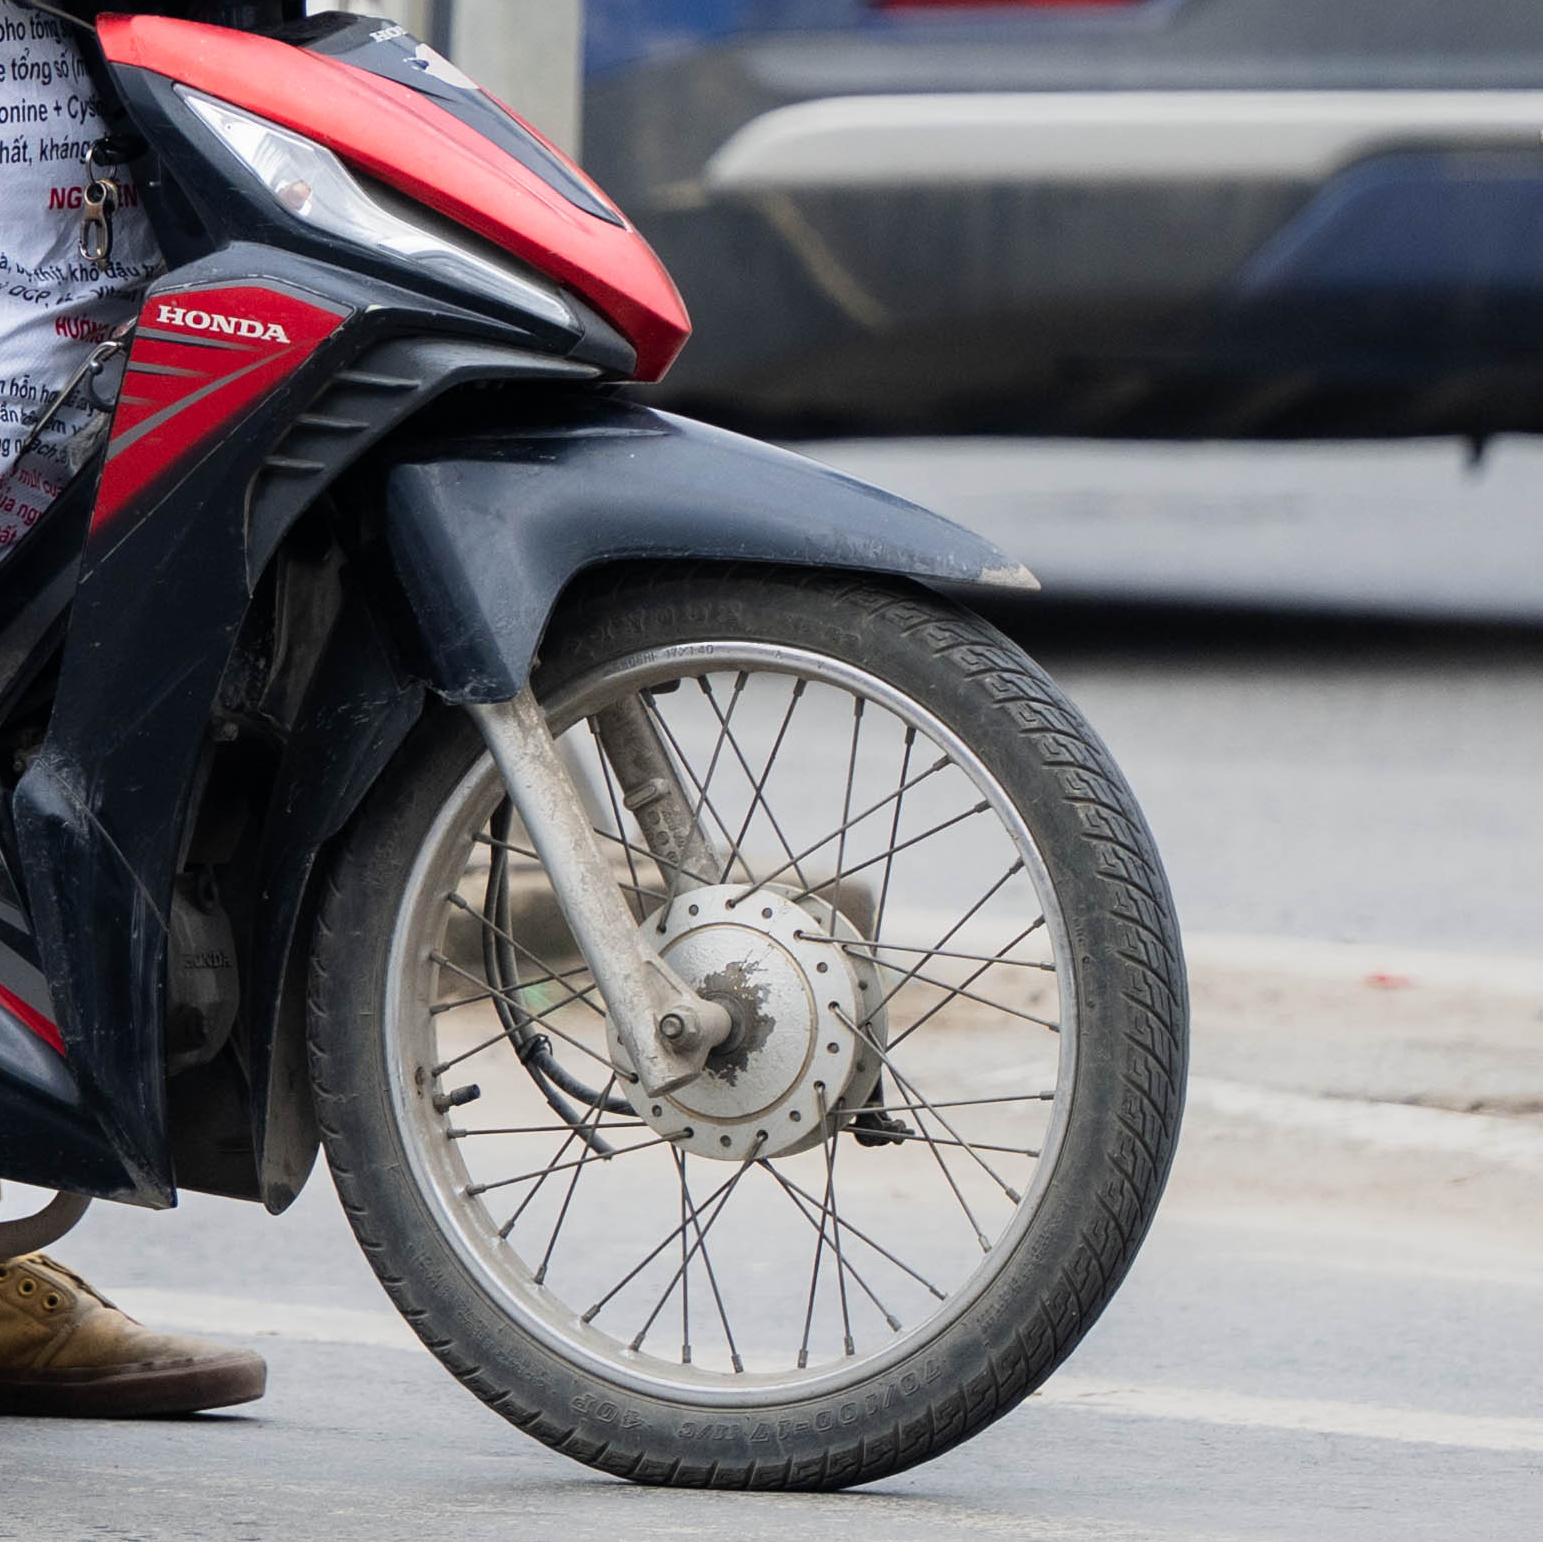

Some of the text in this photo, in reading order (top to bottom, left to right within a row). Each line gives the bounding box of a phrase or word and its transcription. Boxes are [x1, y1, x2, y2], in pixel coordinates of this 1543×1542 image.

[11, 47, 53, 86] tổng
[53, 99, 63, 117] +
[40, 135, 91, 165] kháng
[156, 304, 291, 345] HONDA
[9, 374, 37, 401] hỗn
[570, 1393, 649, 1432] 40P
